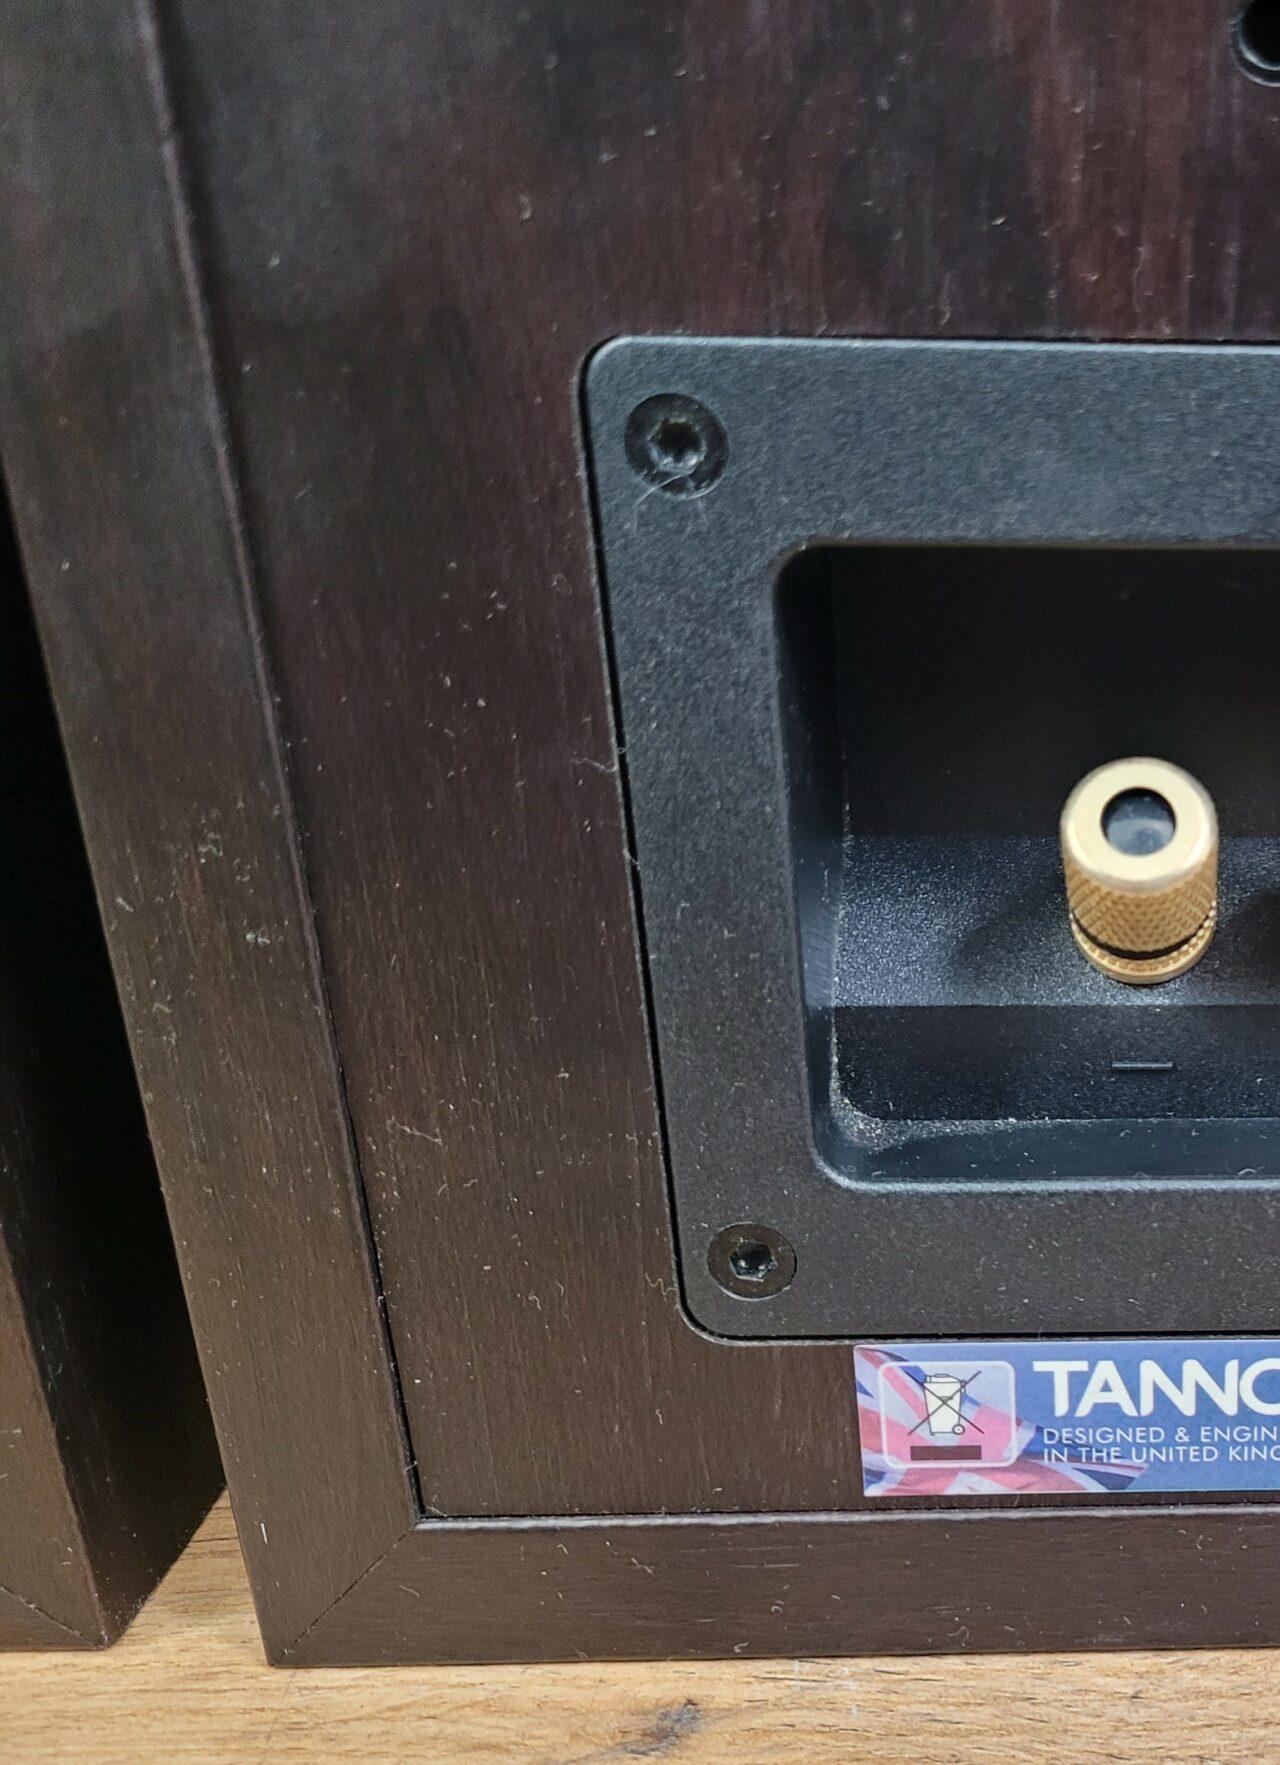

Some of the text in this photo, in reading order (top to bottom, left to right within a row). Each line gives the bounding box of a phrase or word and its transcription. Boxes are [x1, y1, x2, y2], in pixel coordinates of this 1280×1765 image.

[1043, 1426, 1166, 1445] DESIGNED
[1176, 1426, 1191, 1444] &
[1043, 1447, 1069, 1464] IN
[1080, 1446, 1121, 1463] THE
[1131, 1445, 1218, 1463] UNITED
